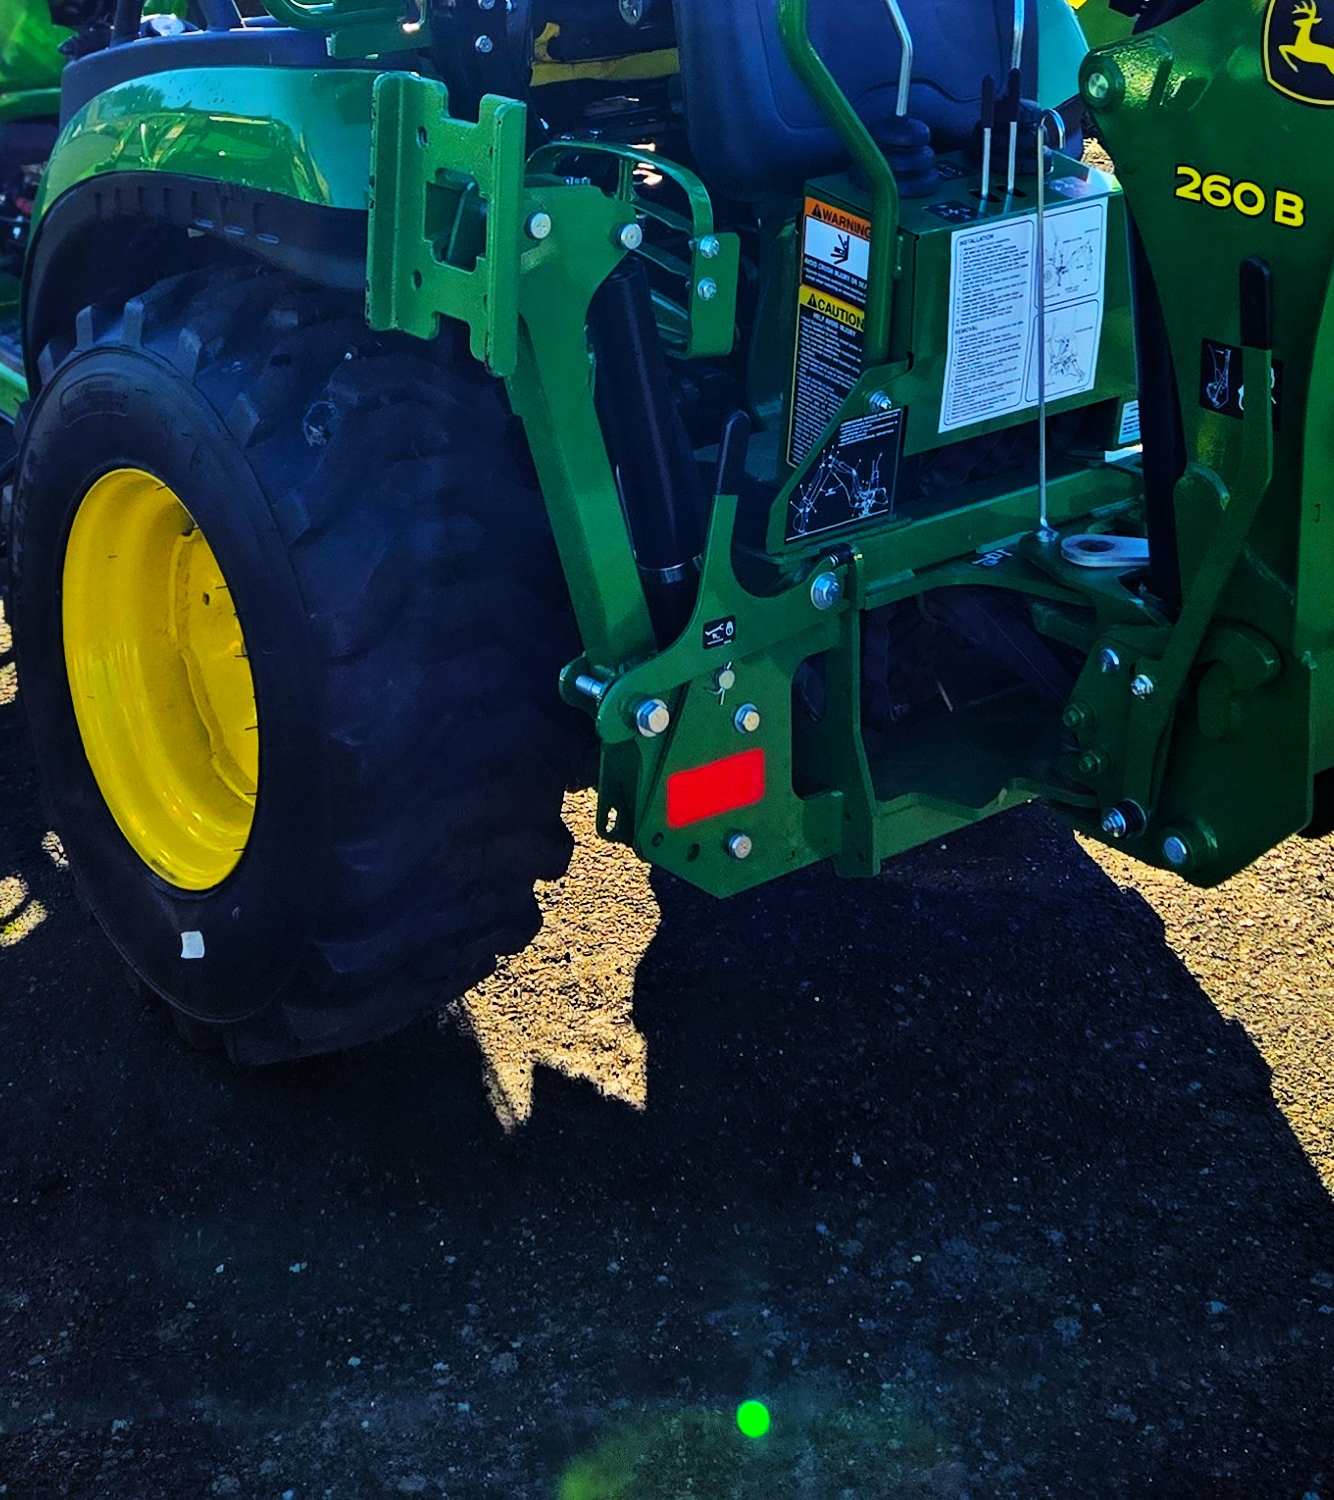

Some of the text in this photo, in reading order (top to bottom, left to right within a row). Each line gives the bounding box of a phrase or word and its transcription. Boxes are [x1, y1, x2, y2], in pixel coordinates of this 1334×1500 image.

[1175, 166, 1304, 227] 260 B
[822, 208, 871, 238] WARNING
[959, 234, 994, 246] INSTALLATION
[818, 299, 864, 329] CAUTION
